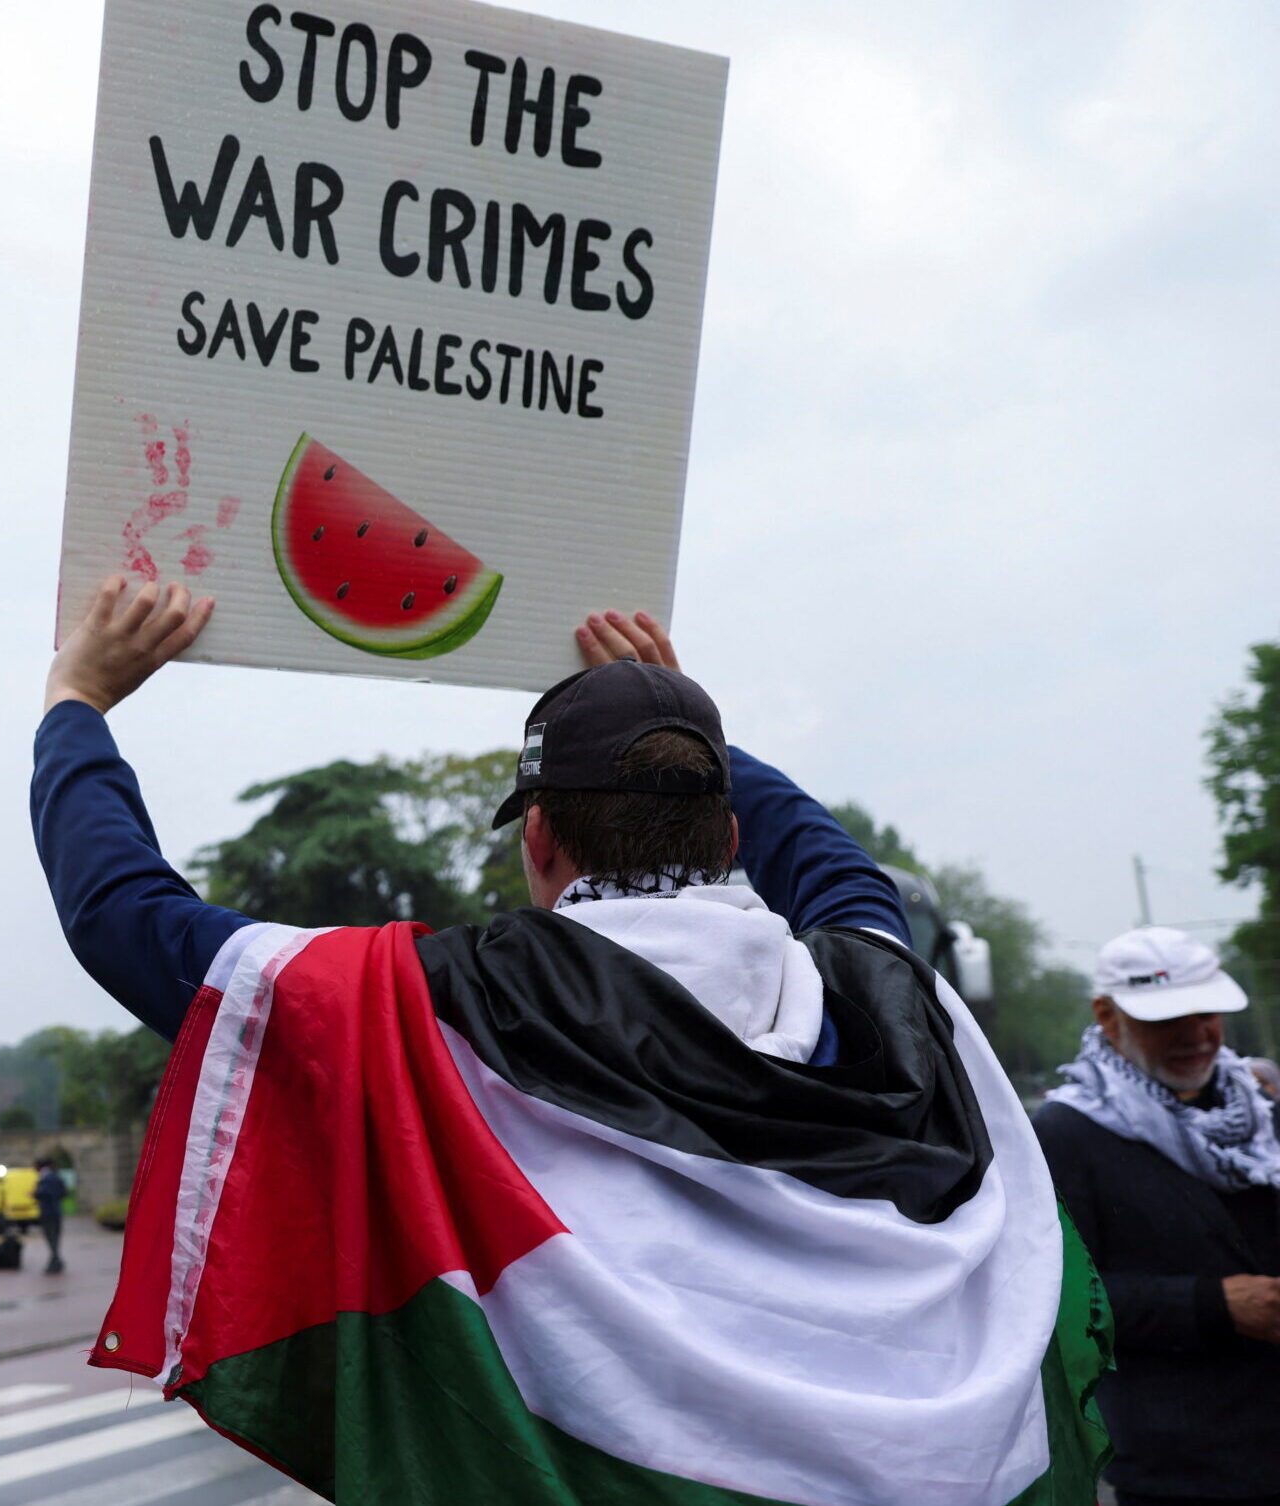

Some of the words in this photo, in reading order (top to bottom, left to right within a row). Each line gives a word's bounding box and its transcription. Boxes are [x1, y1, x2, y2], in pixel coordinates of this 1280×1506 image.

[239, 3, 433, 131] STOP
[463, 49, 603, 169] THE
[148, 134, 345, 266] WAR
[378, 179, 655, 321] CRIMES
[176, 290, 320, 373] SAVE
[344, 317, 605, 419] PALESTINE
